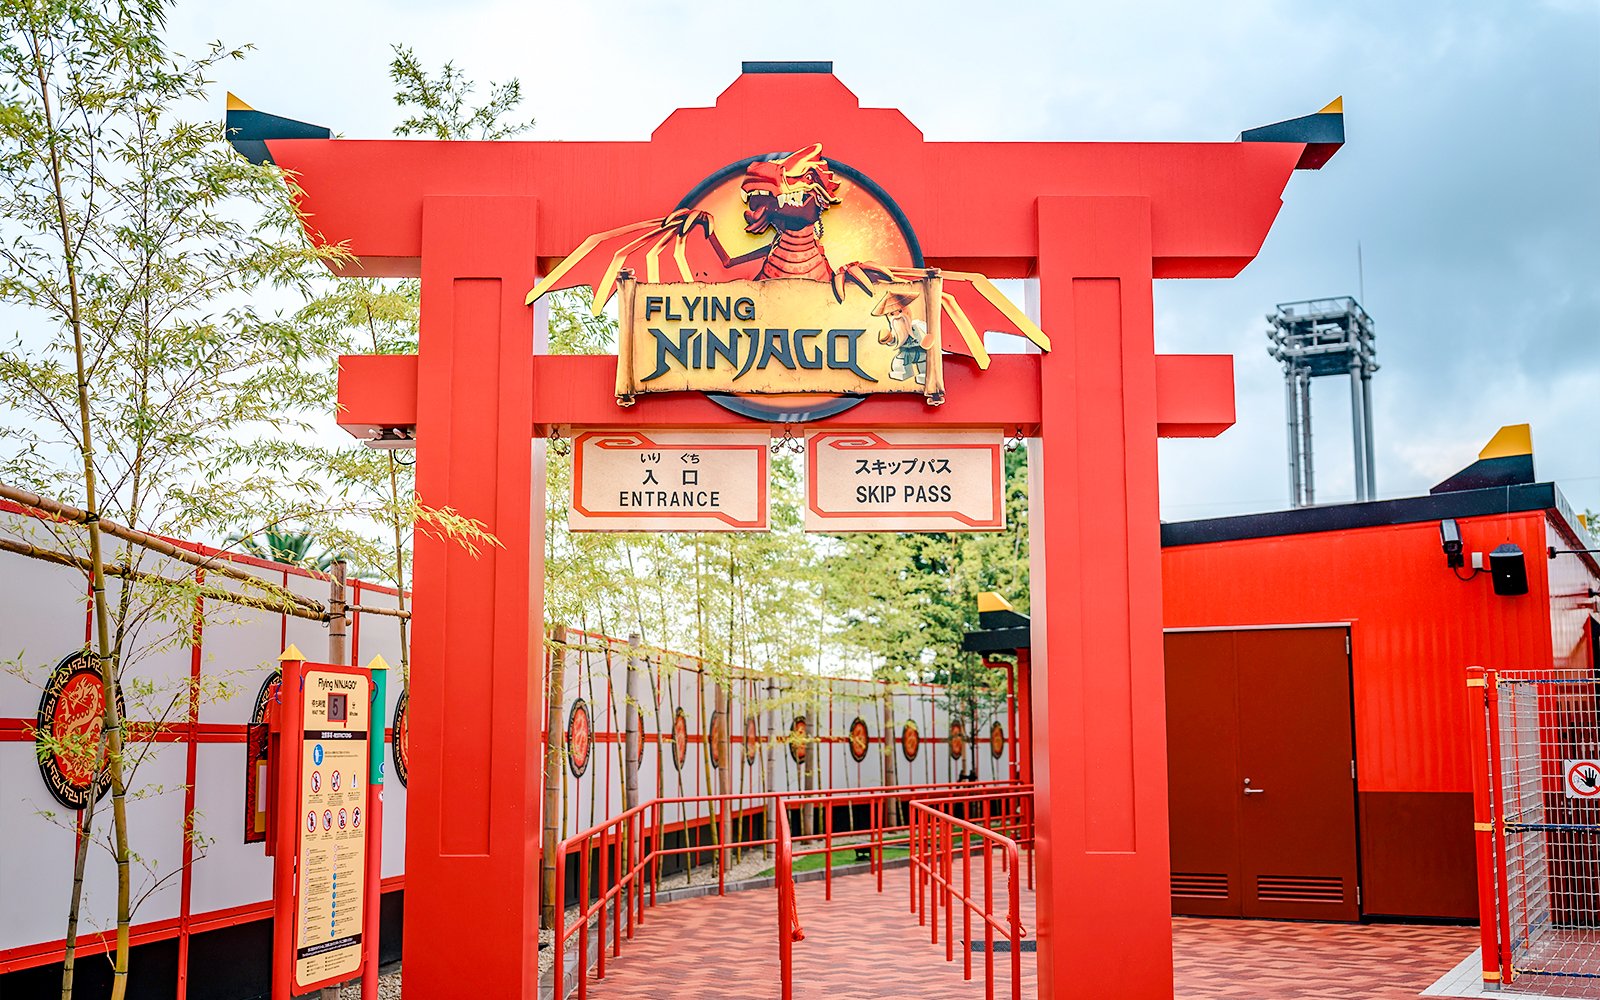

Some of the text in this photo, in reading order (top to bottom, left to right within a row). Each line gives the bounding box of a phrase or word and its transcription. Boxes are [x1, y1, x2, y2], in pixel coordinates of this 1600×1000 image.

[645, 296, 756, 321] FLYING
[640, 327, 879, 383] NINJAGO
[640, 452, 700, 464] いり ぐち
[854, 457, 952, 475] スキップパス
[619, 491, 720, 507] ENTRANCE
[856, 485, 952, 503] SKIP PASS
[318, 678, 333, 691] Flying
[332, 698, 339, 716] 5
